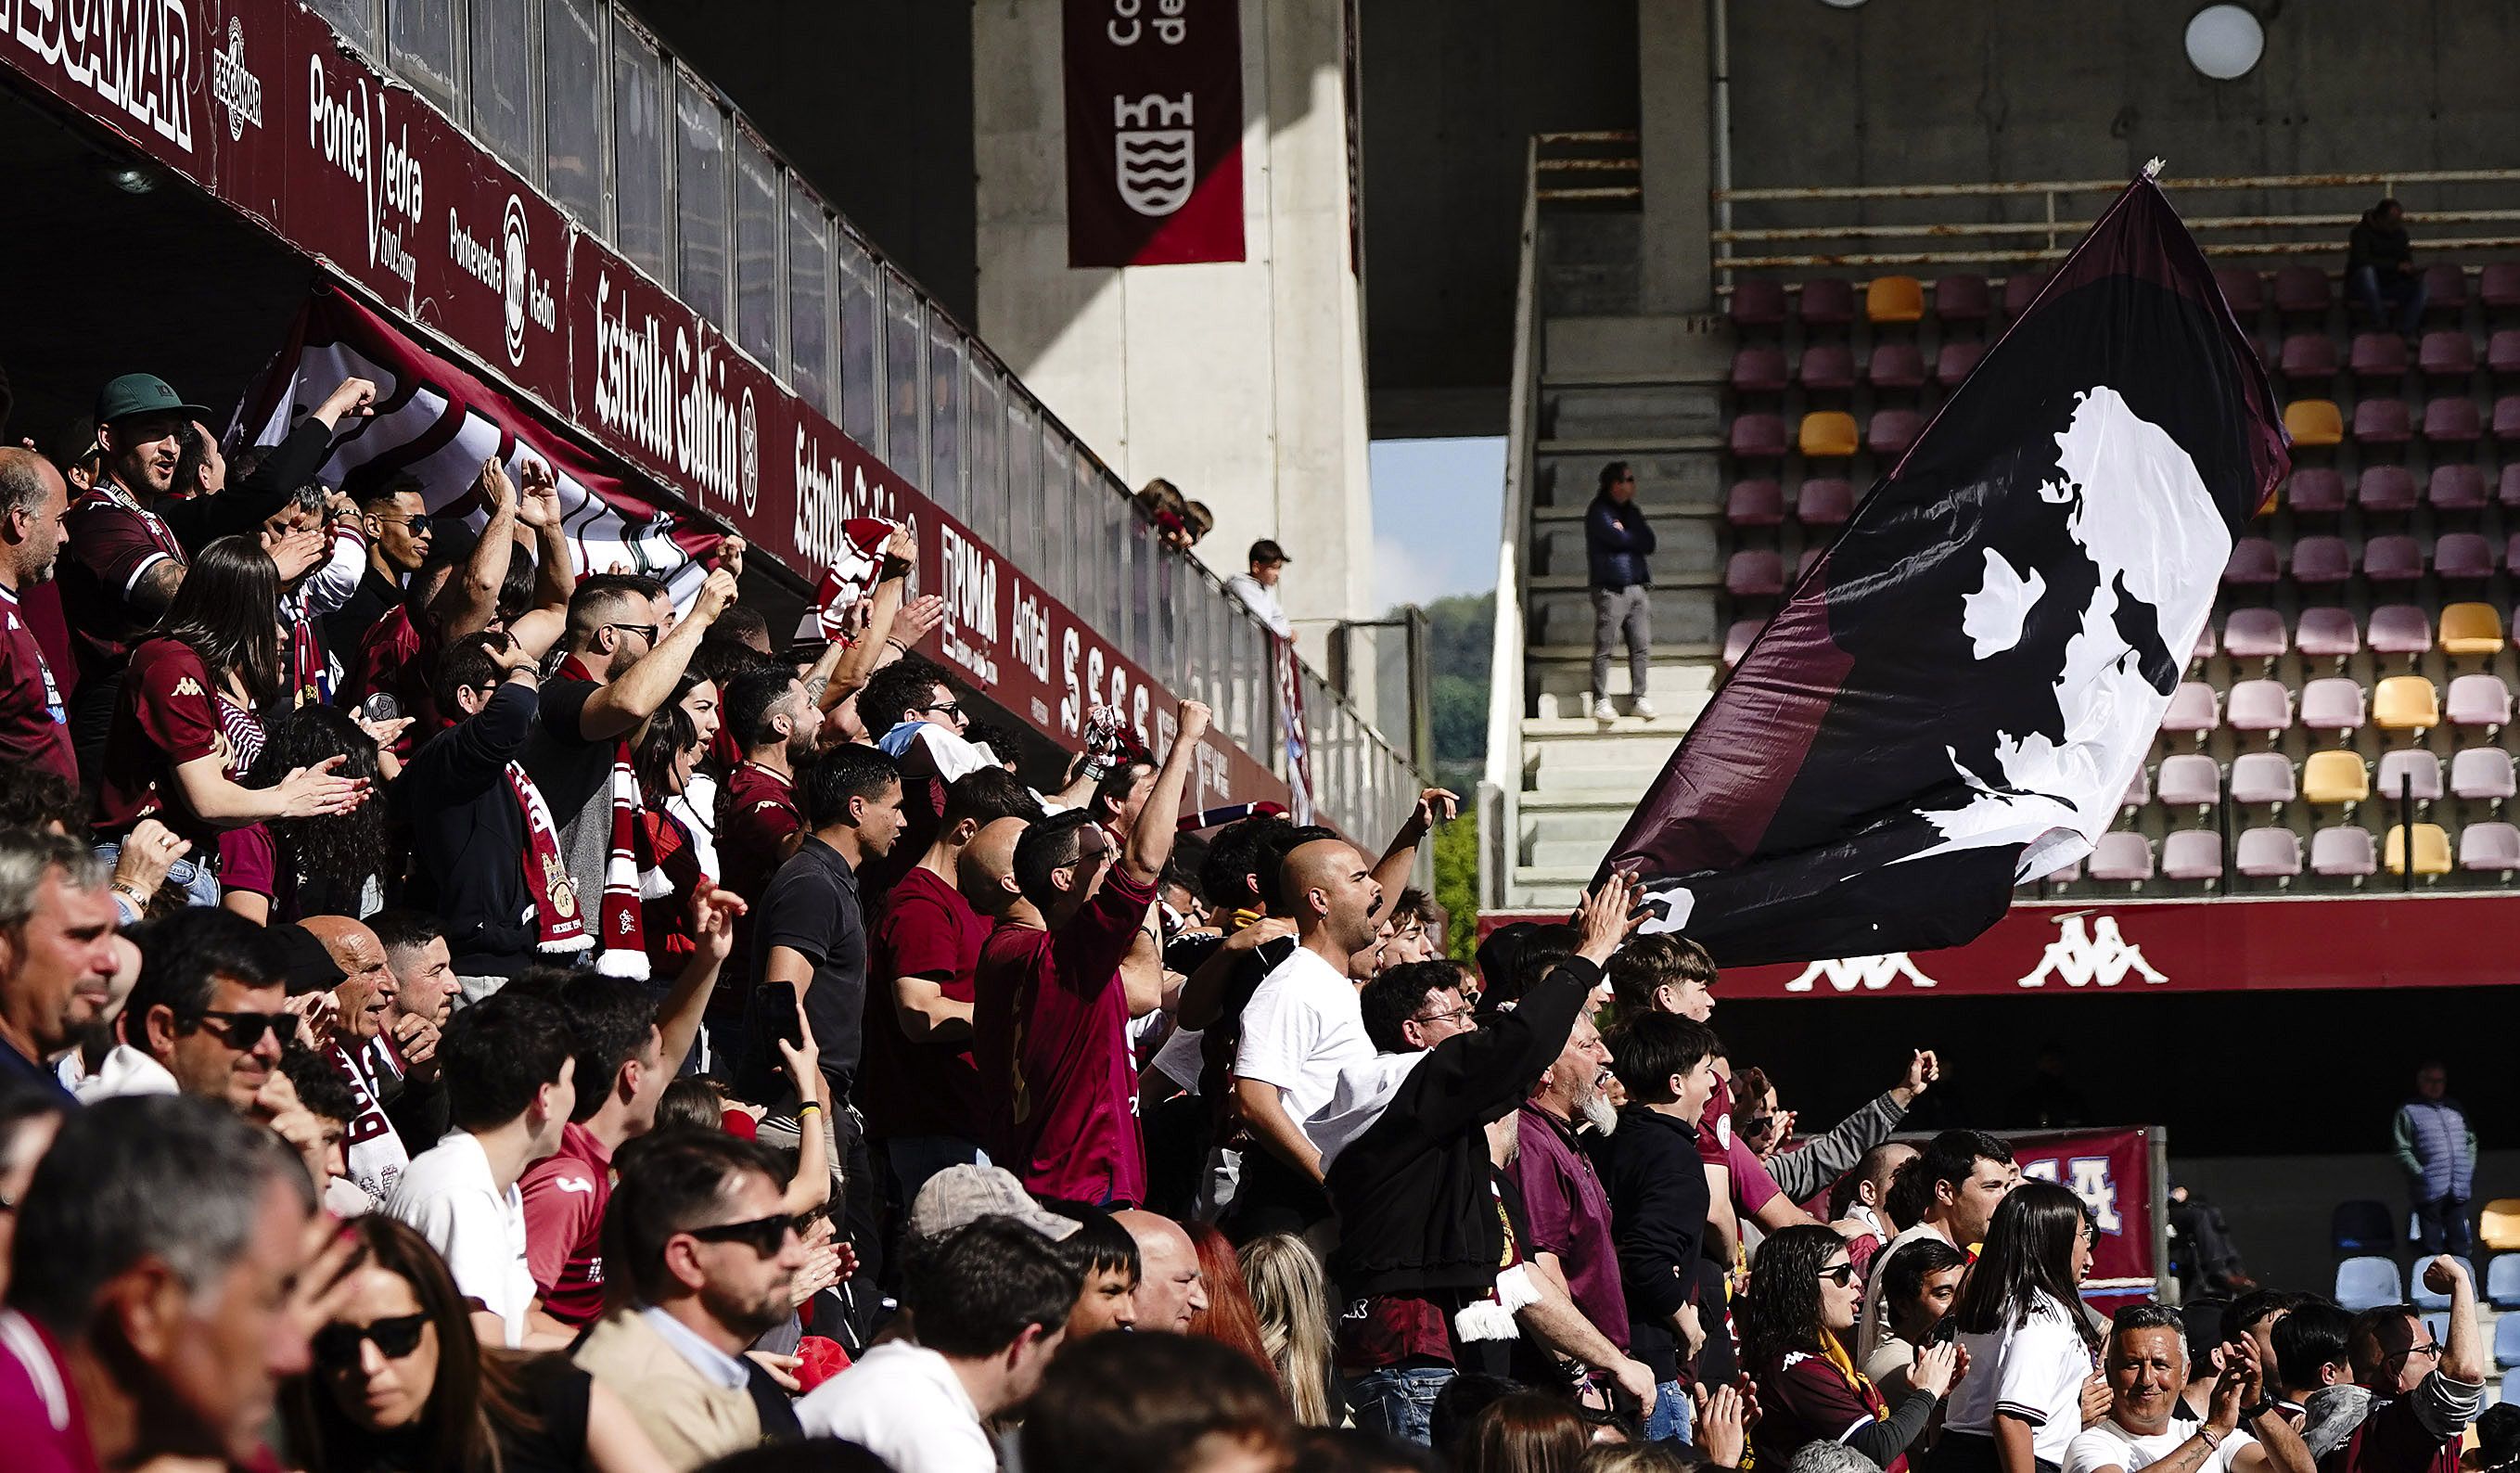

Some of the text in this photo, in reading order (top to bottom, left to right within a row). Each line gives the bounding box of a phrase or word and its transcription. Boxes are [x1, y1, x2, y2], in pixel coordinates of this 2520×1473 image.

[0, 0, 193, 154] CAMAR
[213, 47, 262, 129] PESCAMAR
[449, 207, 502, 295] Pontevedra
[530, 267, 556, 333] Radio
[595, 270, 738, 506] Estrella Galicia
[793, 421, 852, 569] Estrell
